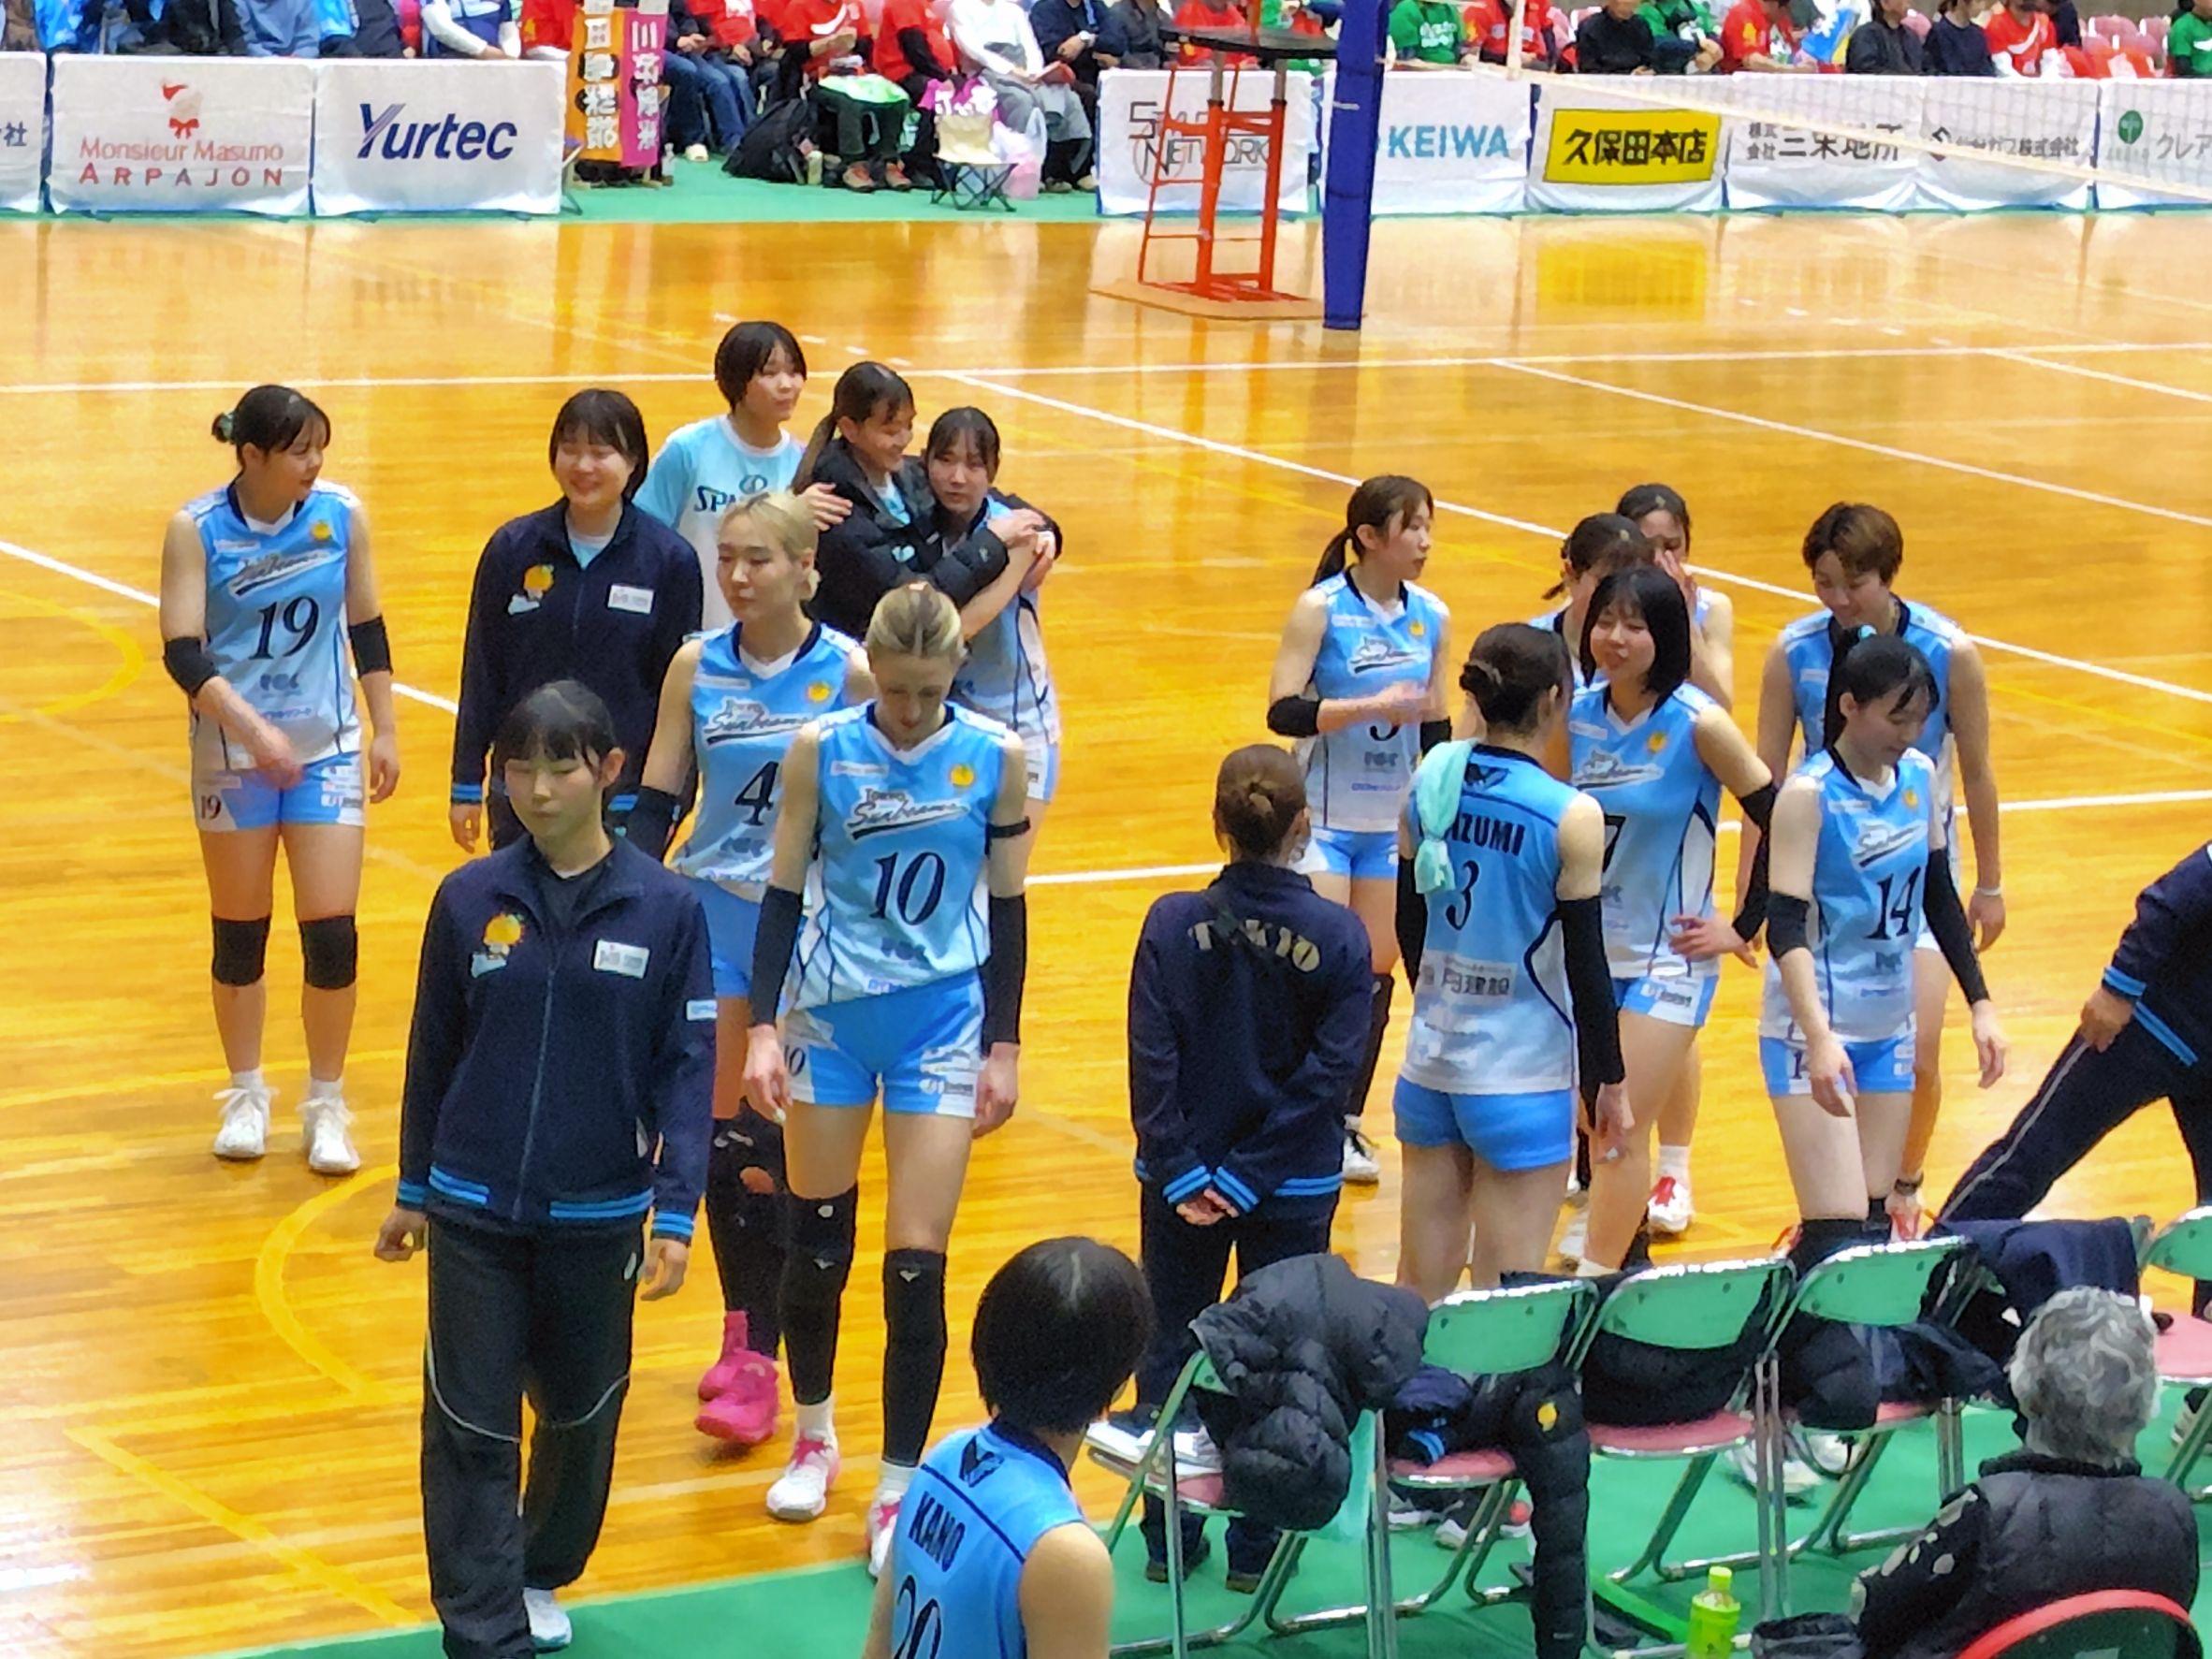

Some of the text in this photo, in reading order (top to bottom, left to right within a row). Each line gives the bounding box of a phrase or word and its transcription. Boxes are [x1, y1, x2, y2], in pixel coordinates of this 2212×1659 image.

[79, 137, 188, 162] Monsieur
[357, 103, 518, 160] Yurtec
[1142, 137, 1273, 176] NETORK
[1387, 125, 1509, 158] KEIWA
[1562, 127, 1708, 167] 久保田本店
[79, 162, 283, 187] ARPAJON
[248, 595, 320, 660] 19
[201, 794, 221, 820] 19
[735, 761, 779, 826] 4
[869, 851, 945, 925] 10
[1446, 860, 1479, 931] 3
[1863, 866, 1922, 940] 14
[908, 1491, 966, 1573] KANO
[893, 1574, 942, 1659] 20
